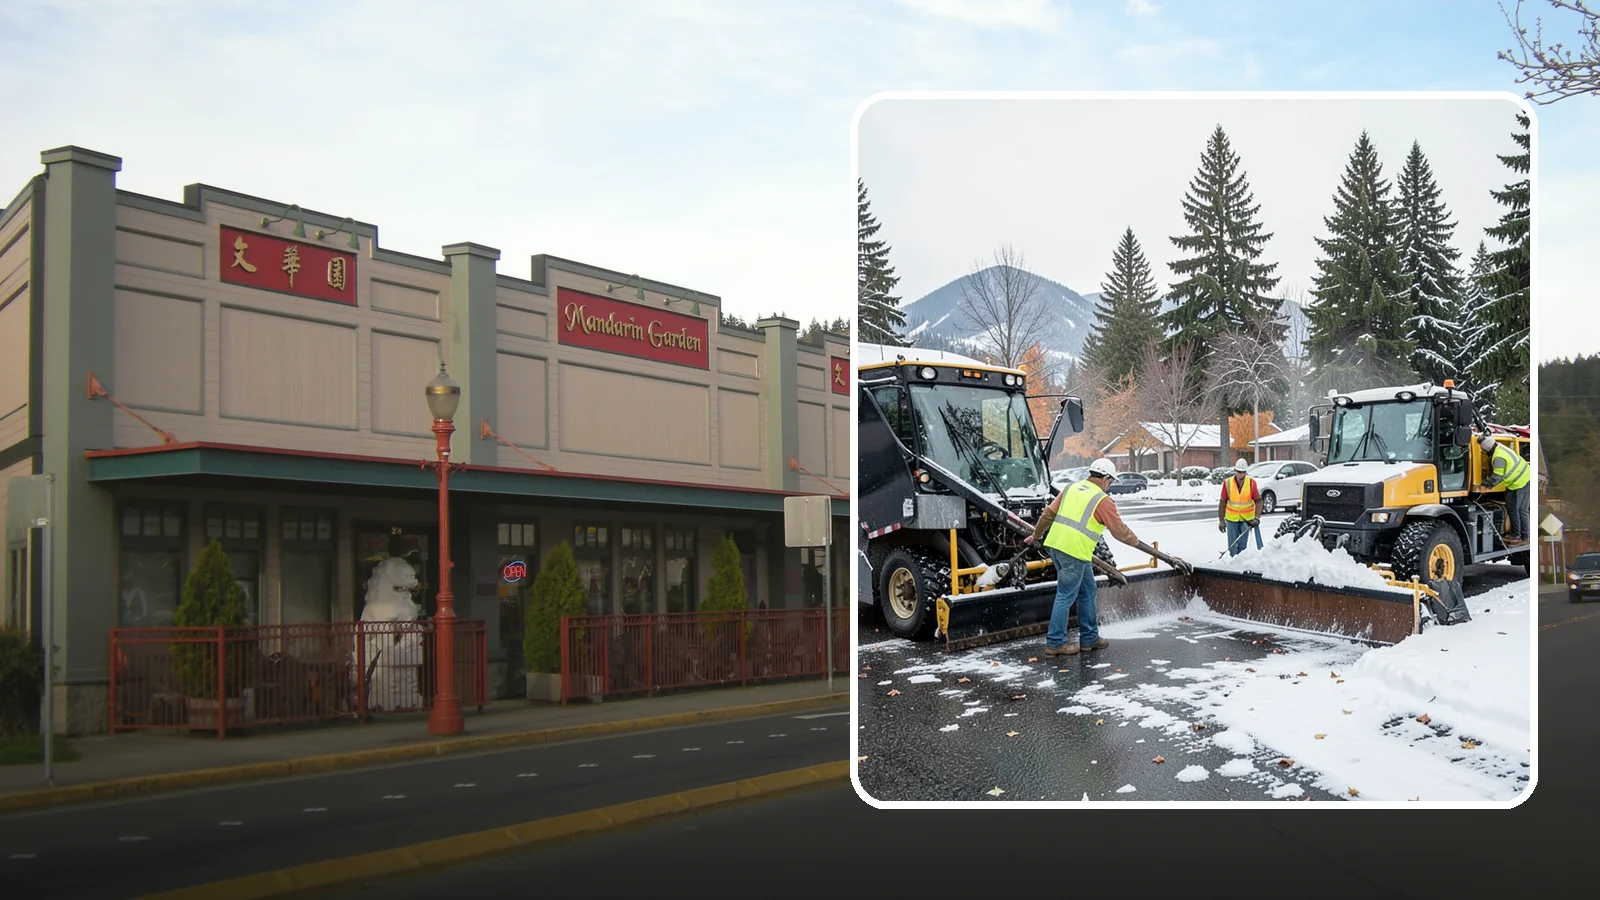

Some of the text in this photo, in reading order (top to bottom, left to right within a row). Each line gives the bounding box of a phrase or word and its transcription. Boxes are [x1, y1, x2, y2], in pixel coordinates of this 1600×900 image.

[230, 235, 346, 292] 文華園
[564, 302, 702, 352] Mandarin Garden
[503, 565, 527, 578] OPEN
